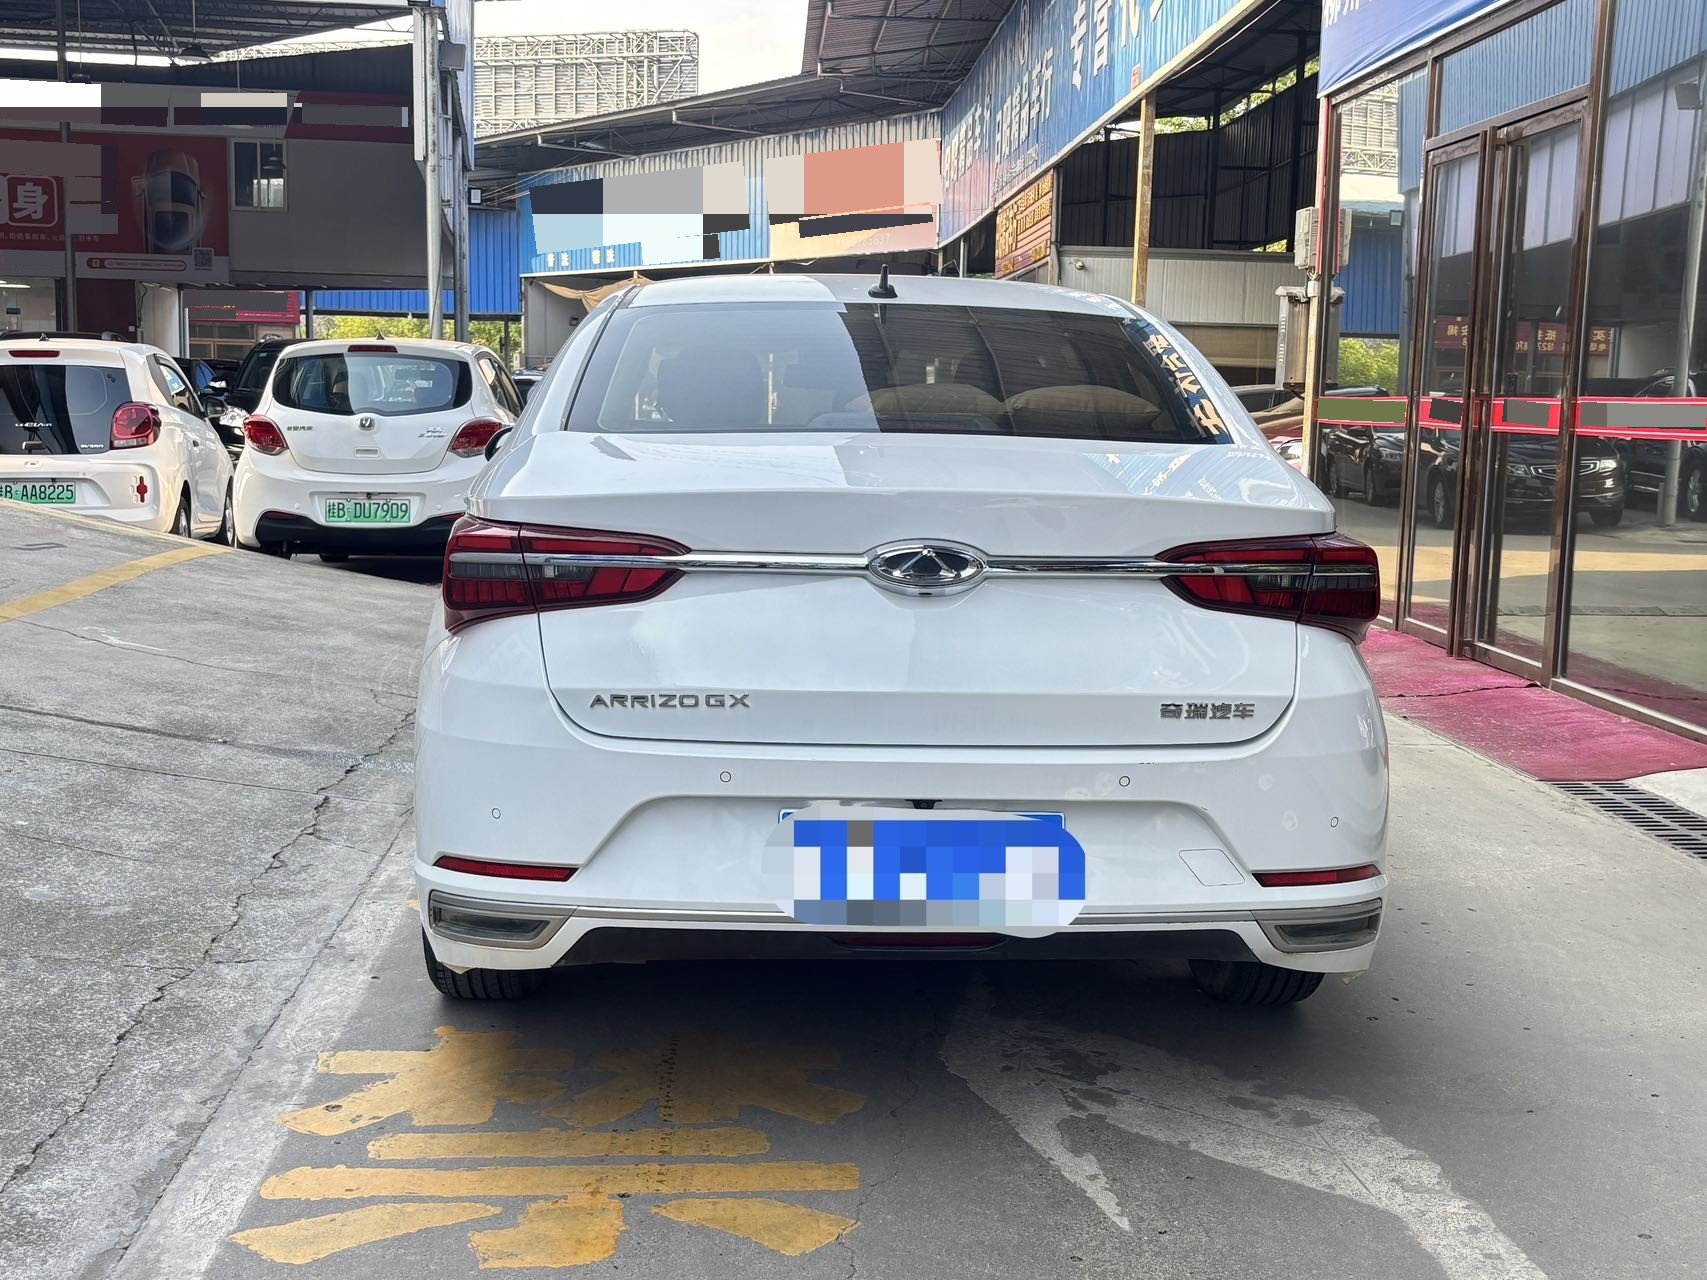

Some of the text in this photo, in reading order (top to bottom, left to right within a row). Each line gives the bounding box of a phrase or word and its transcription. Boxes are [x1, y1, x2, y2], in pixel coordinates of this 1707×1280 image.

[13, 182, 48, 219] 身
[21, 484, 74, 500] AA8225
[328, 502, 408, 519] 桂B DU7909
[589, 693, 750, 709] ARRIZO GX
[1160, 702, 1255, 720] 奇瑞汽车
